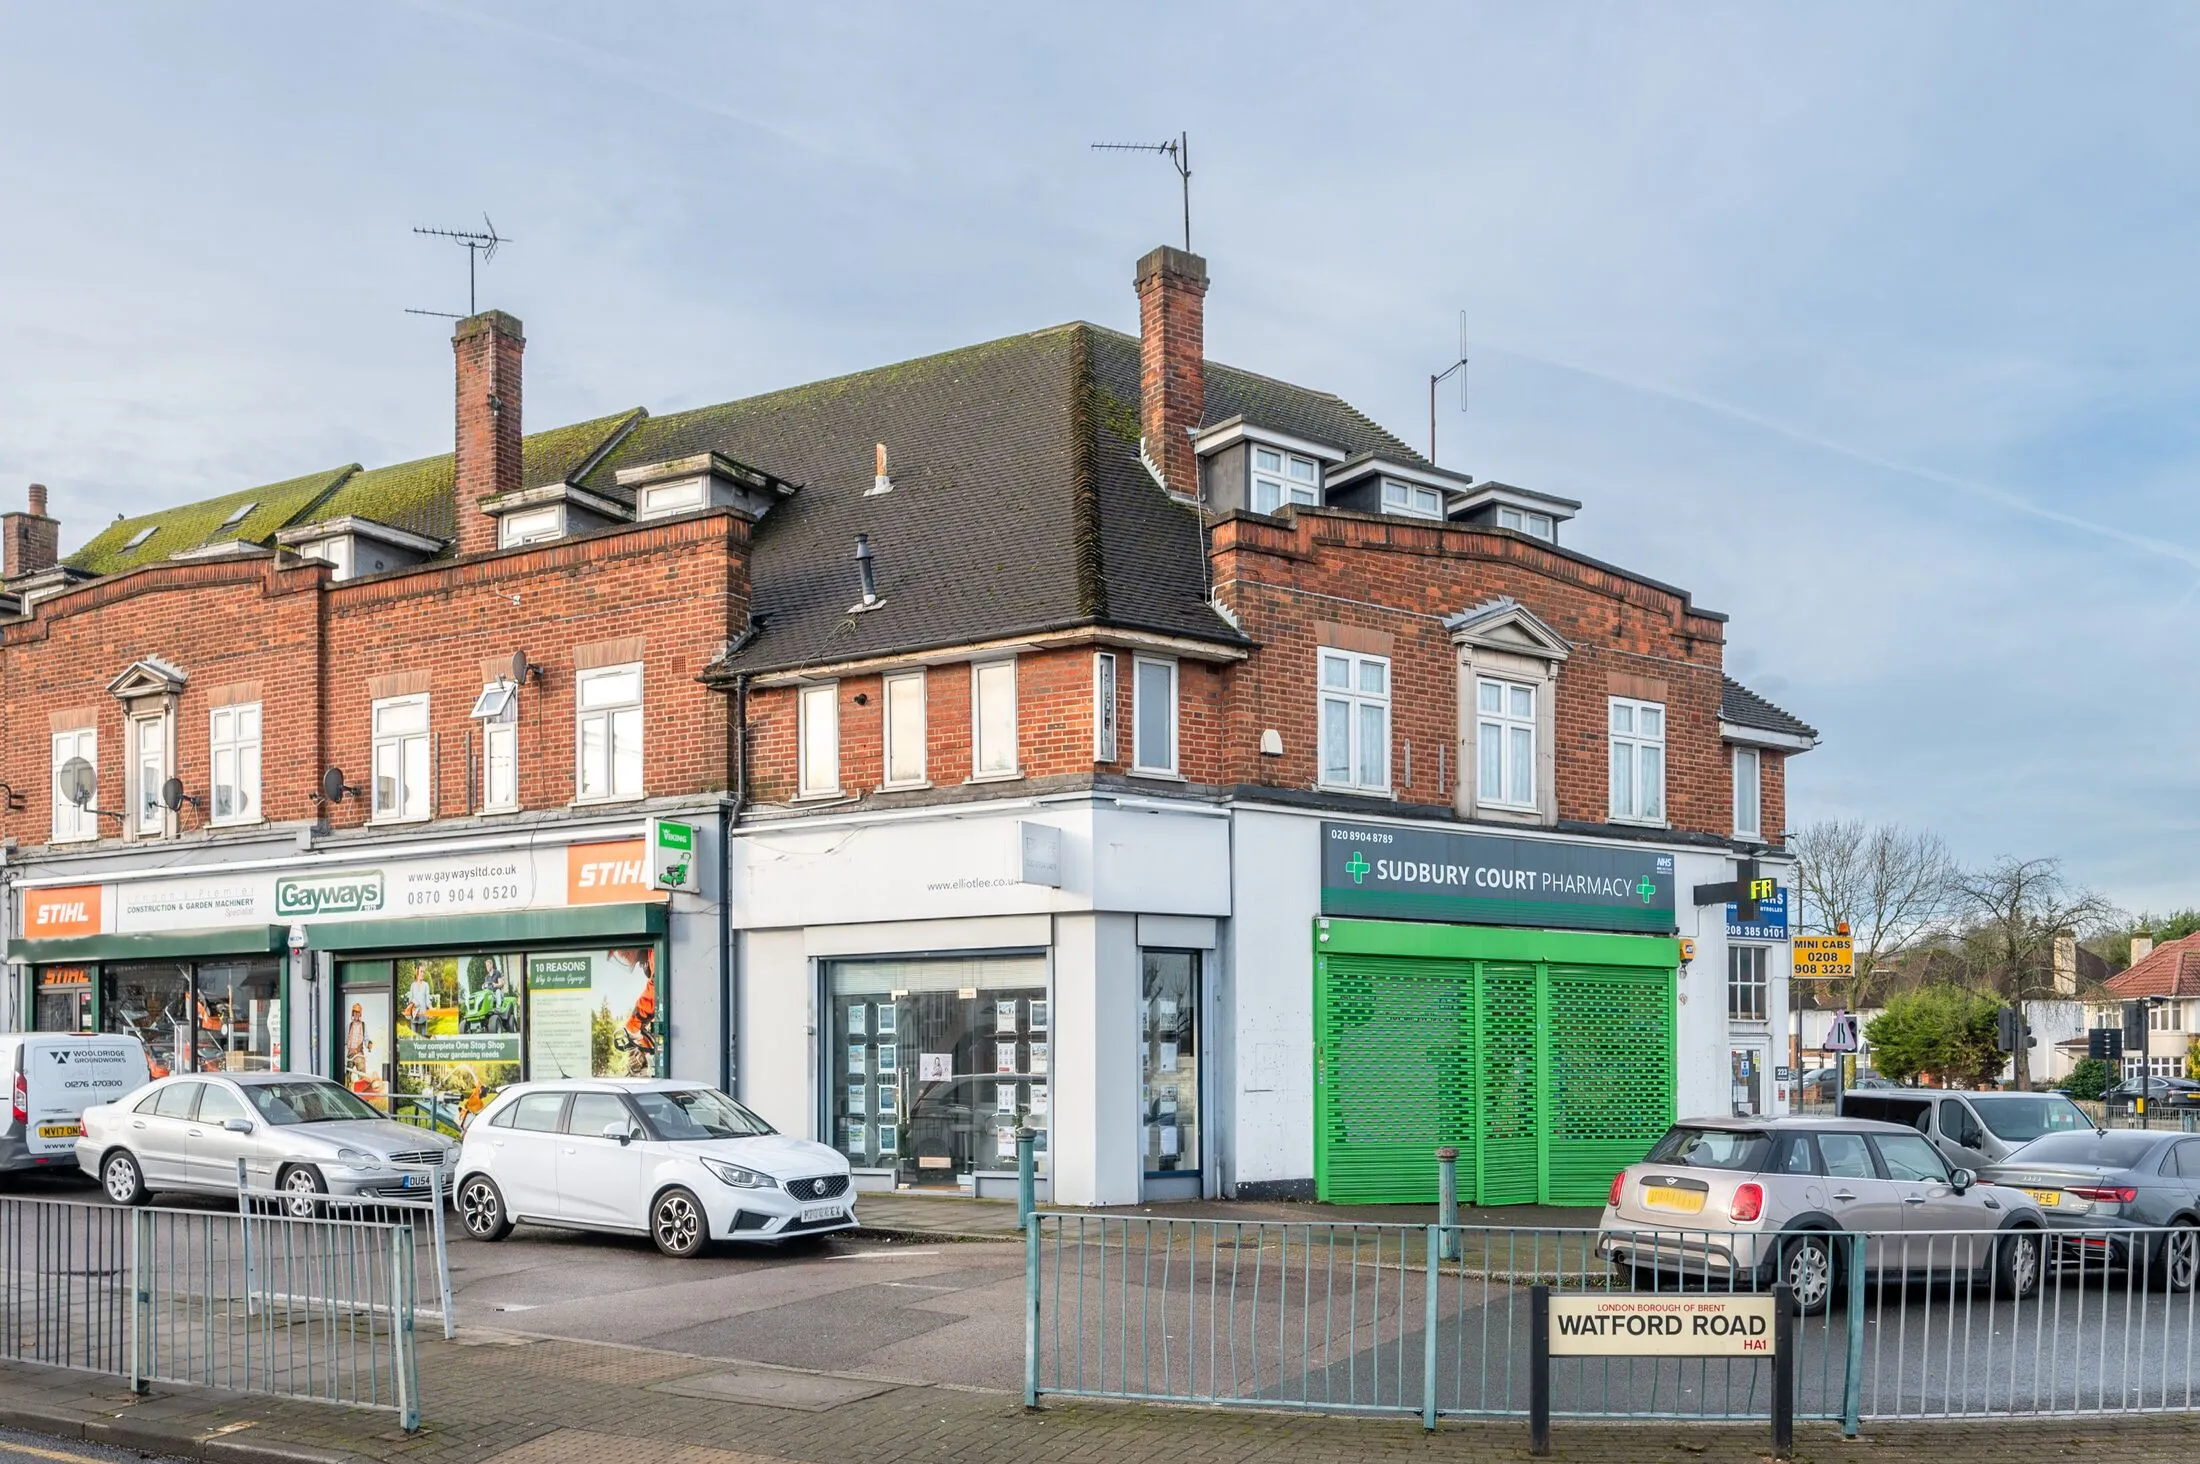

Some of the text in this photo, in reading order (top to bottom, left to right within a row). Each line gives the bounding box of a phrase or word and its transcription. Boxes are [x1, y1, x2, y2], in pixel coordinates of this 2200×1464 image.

[1331, 829, 1393, 844] 020 8904 8789
[1656, 857, 1672, 867] NHS
[408, 864, 517, 883] www.gaywaysltd.co.uk
[1376, 859, 1632, 897] SUDBURY COURT PHARMACY
[408, 885, 518, 905] 0870 904 0520
[1750, 879, 1772, 900] FR
[281, 882, 379, 911] Gayways
[127, 897, 254, 914] CONSTRUCTION & GARDEN MACHINERY
[36, 902, 89, 925] STIHL
[1744, 926, 1761, 937] 385
[1763, 927, 1784, 938] 0101
[1794, 940, 1851, 949] MINI CABS
[1807, 952, 1838, 962] 0208
[535, 961, 586, 973] 10 REASONS
[1794, 964, 1851, 974] 908 3232
[413, 1041, 505, 1051] Your complete One Stop Shop
[418, 1051, 499, 1060] for all your gardening needs
[1597, 1304, 1725, 1312] LONDON BOROUGH OF BRENT
[1557, 1314, 1767, 1336] WATFORD ROAD
[1743, 1339, 1767, 1350] HA1
